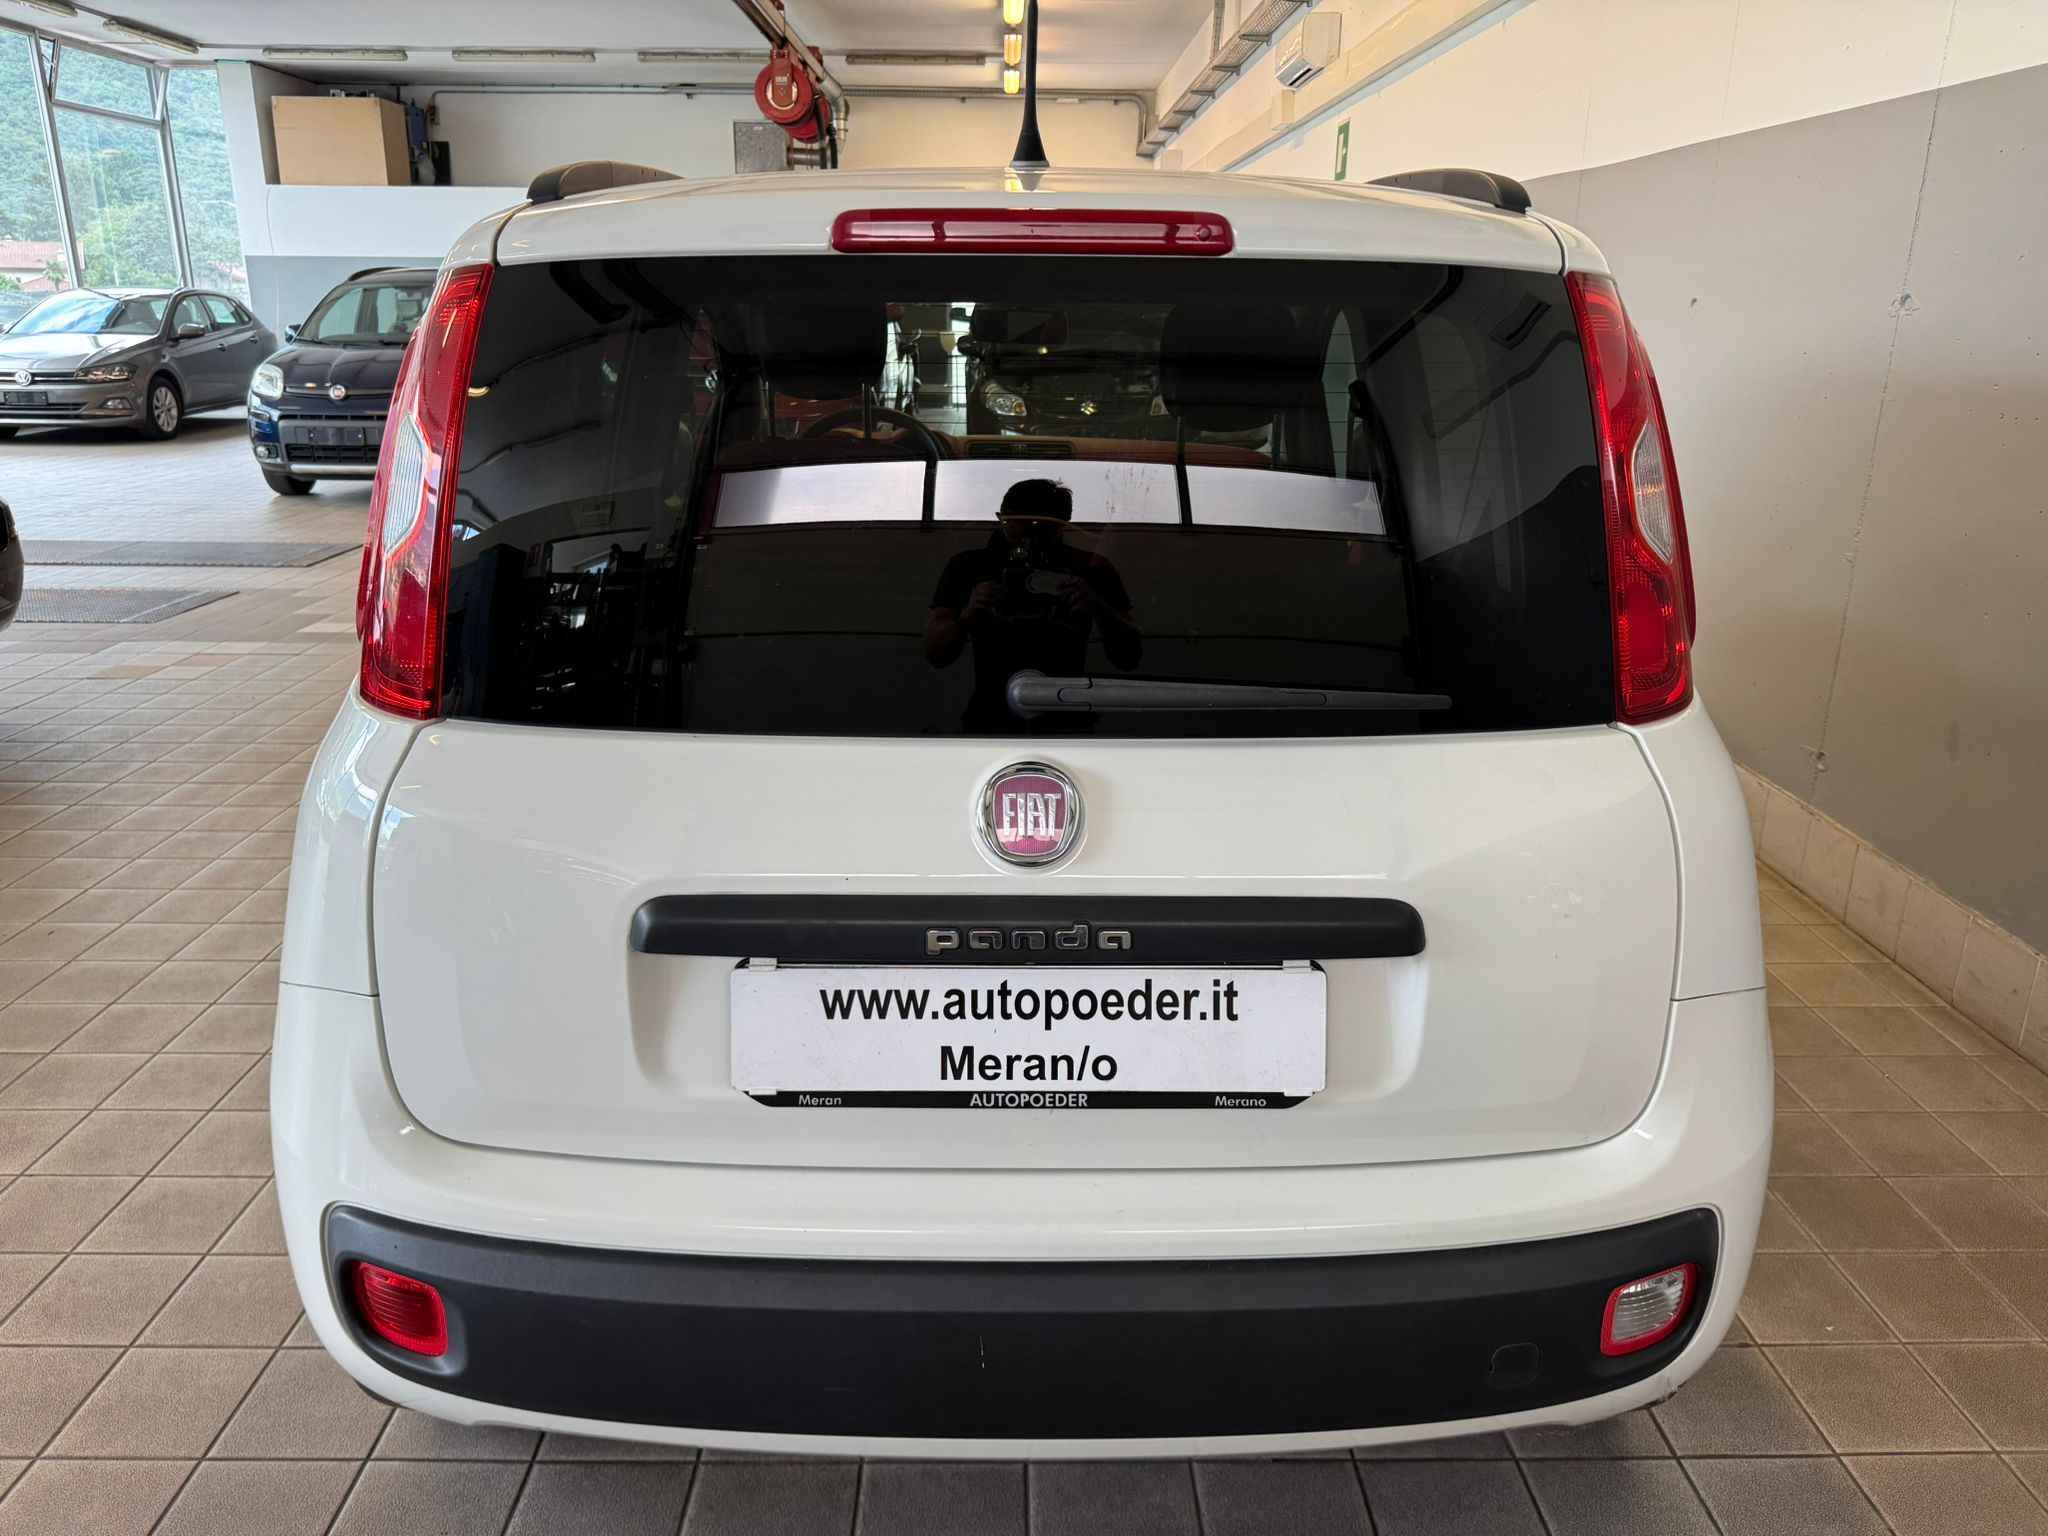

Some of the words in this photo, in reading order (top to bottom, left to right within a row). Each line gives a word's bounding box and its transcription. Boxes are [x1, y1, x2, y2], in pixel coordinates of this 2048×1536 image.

[1002, 792, 1062, 838] FIAT
[926, 923, 1132, 956] panda
[819, 978, 1239, 1030] www.autopoeder.it
[940, 1045, 1118, 1081] Meran/o
[798, 1094, 842, 1106] Meran
[969, 1093, 1089, 1107] AUTOPOEDER
[1214, 1095, 1267, 1107] Merano
